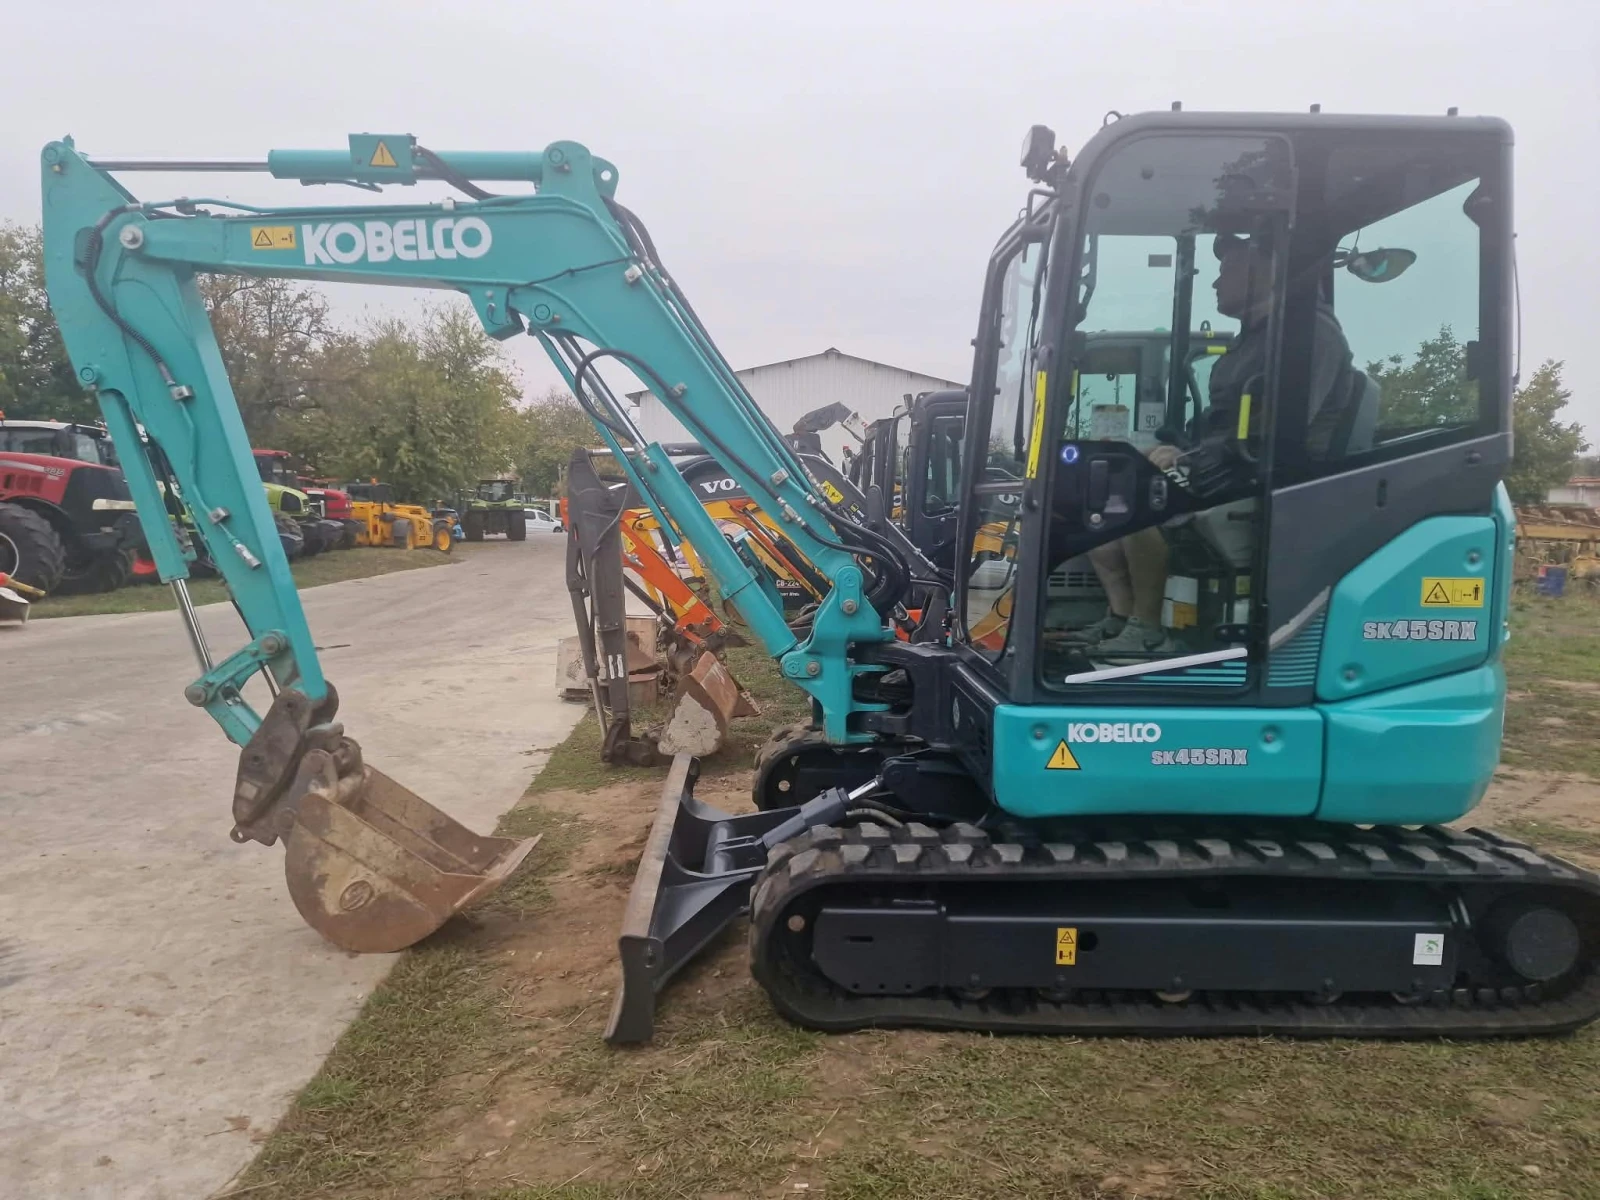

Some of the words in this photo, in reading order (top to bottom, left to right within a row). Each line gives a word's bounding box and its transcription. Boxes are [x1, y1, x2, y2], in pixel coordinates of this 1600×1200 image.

[301, 216, 493, 265] KOBELCO
[700, 478, 742, 494] VO
[1363, 619, 1477, 641] SK45SRX
[1068, 722, 1162, 743] KOBELCO
[1151, 748, 1248, 767] SK45SRX
